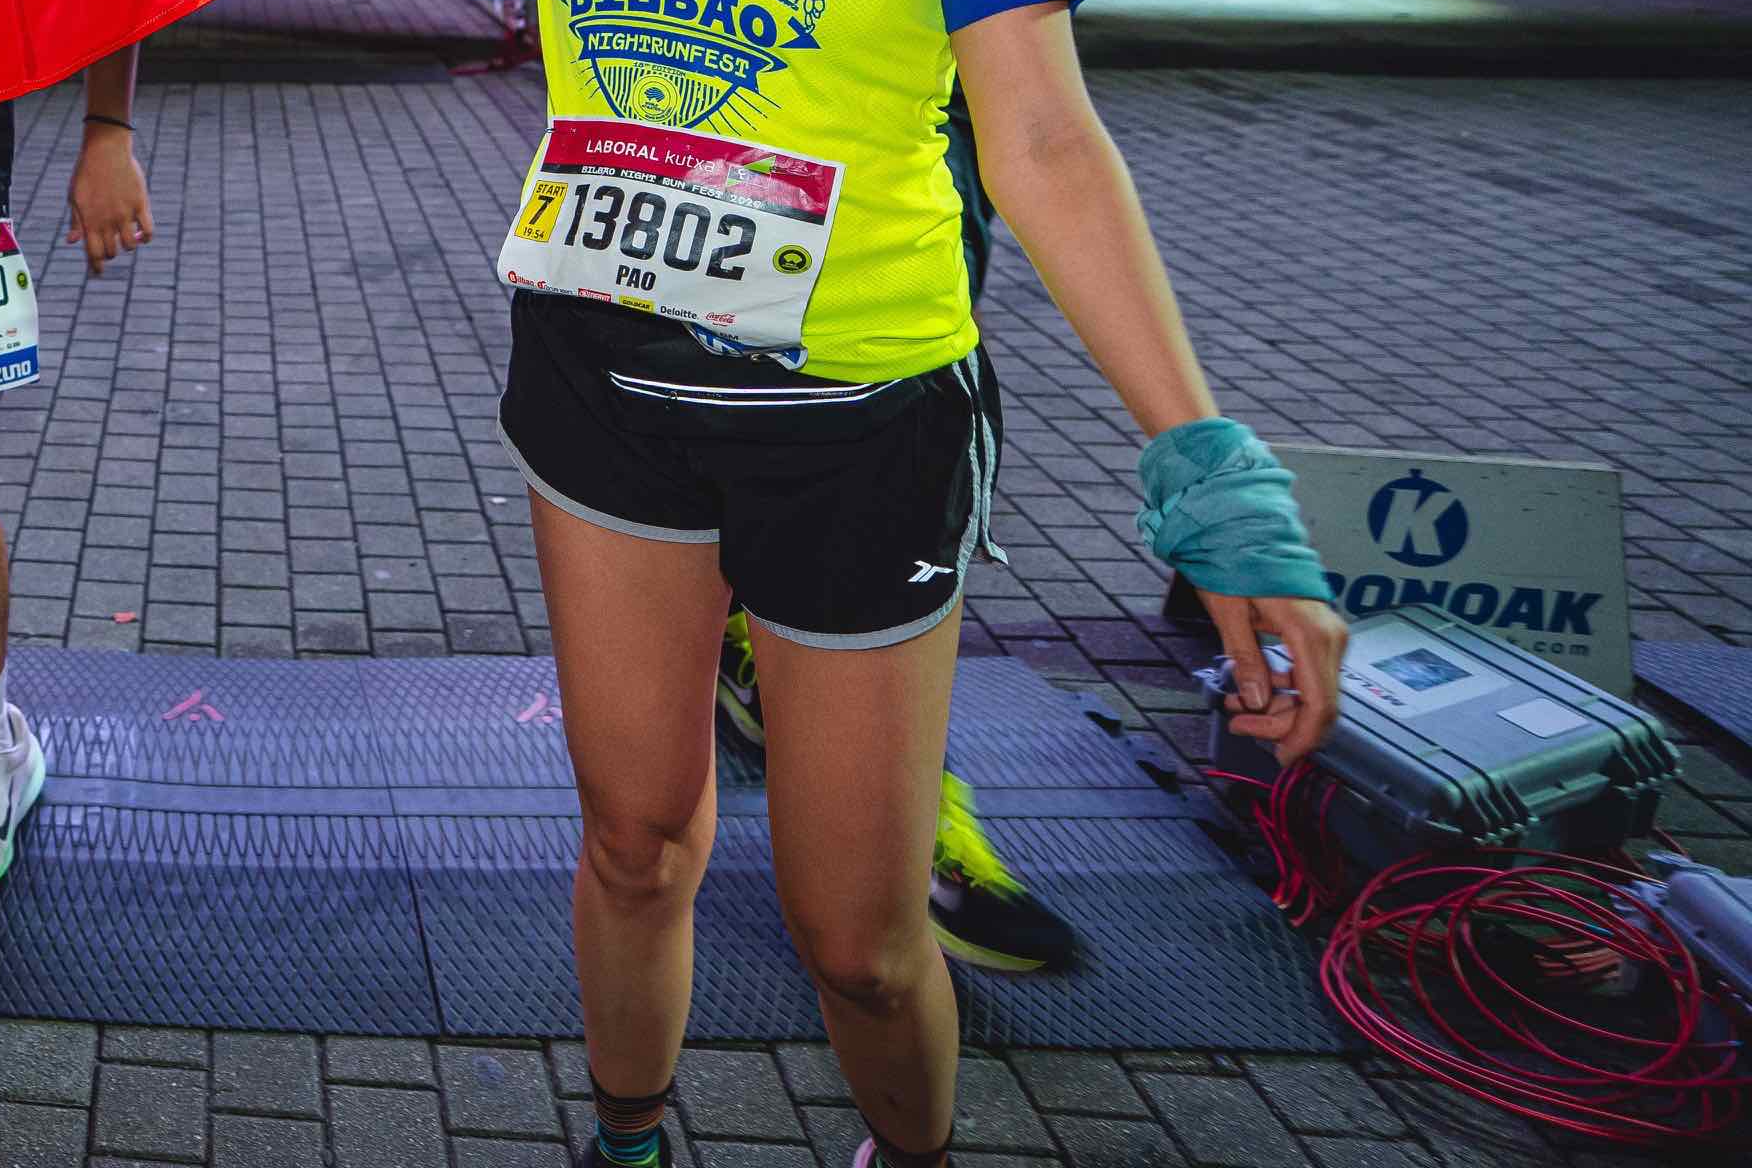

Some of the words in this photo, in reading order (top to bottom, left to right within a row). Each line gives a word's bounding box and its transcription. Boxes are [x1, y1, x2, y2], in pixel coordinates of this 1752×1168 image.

[588, 31, 750, 79] NIGHTRUNFEST
[586, 139, 659, 162] LABORAL
[663, 149, 715, 173] kutxa
[536, 184, 568, 196] START
[620, 170, 657, 183] NIGHT
[662, 177, 687, 190] RUN
[528, 195, 554, 226] 7
[564, 182, 757, 281] 13802
[615, 264, 657, 292] PAO
